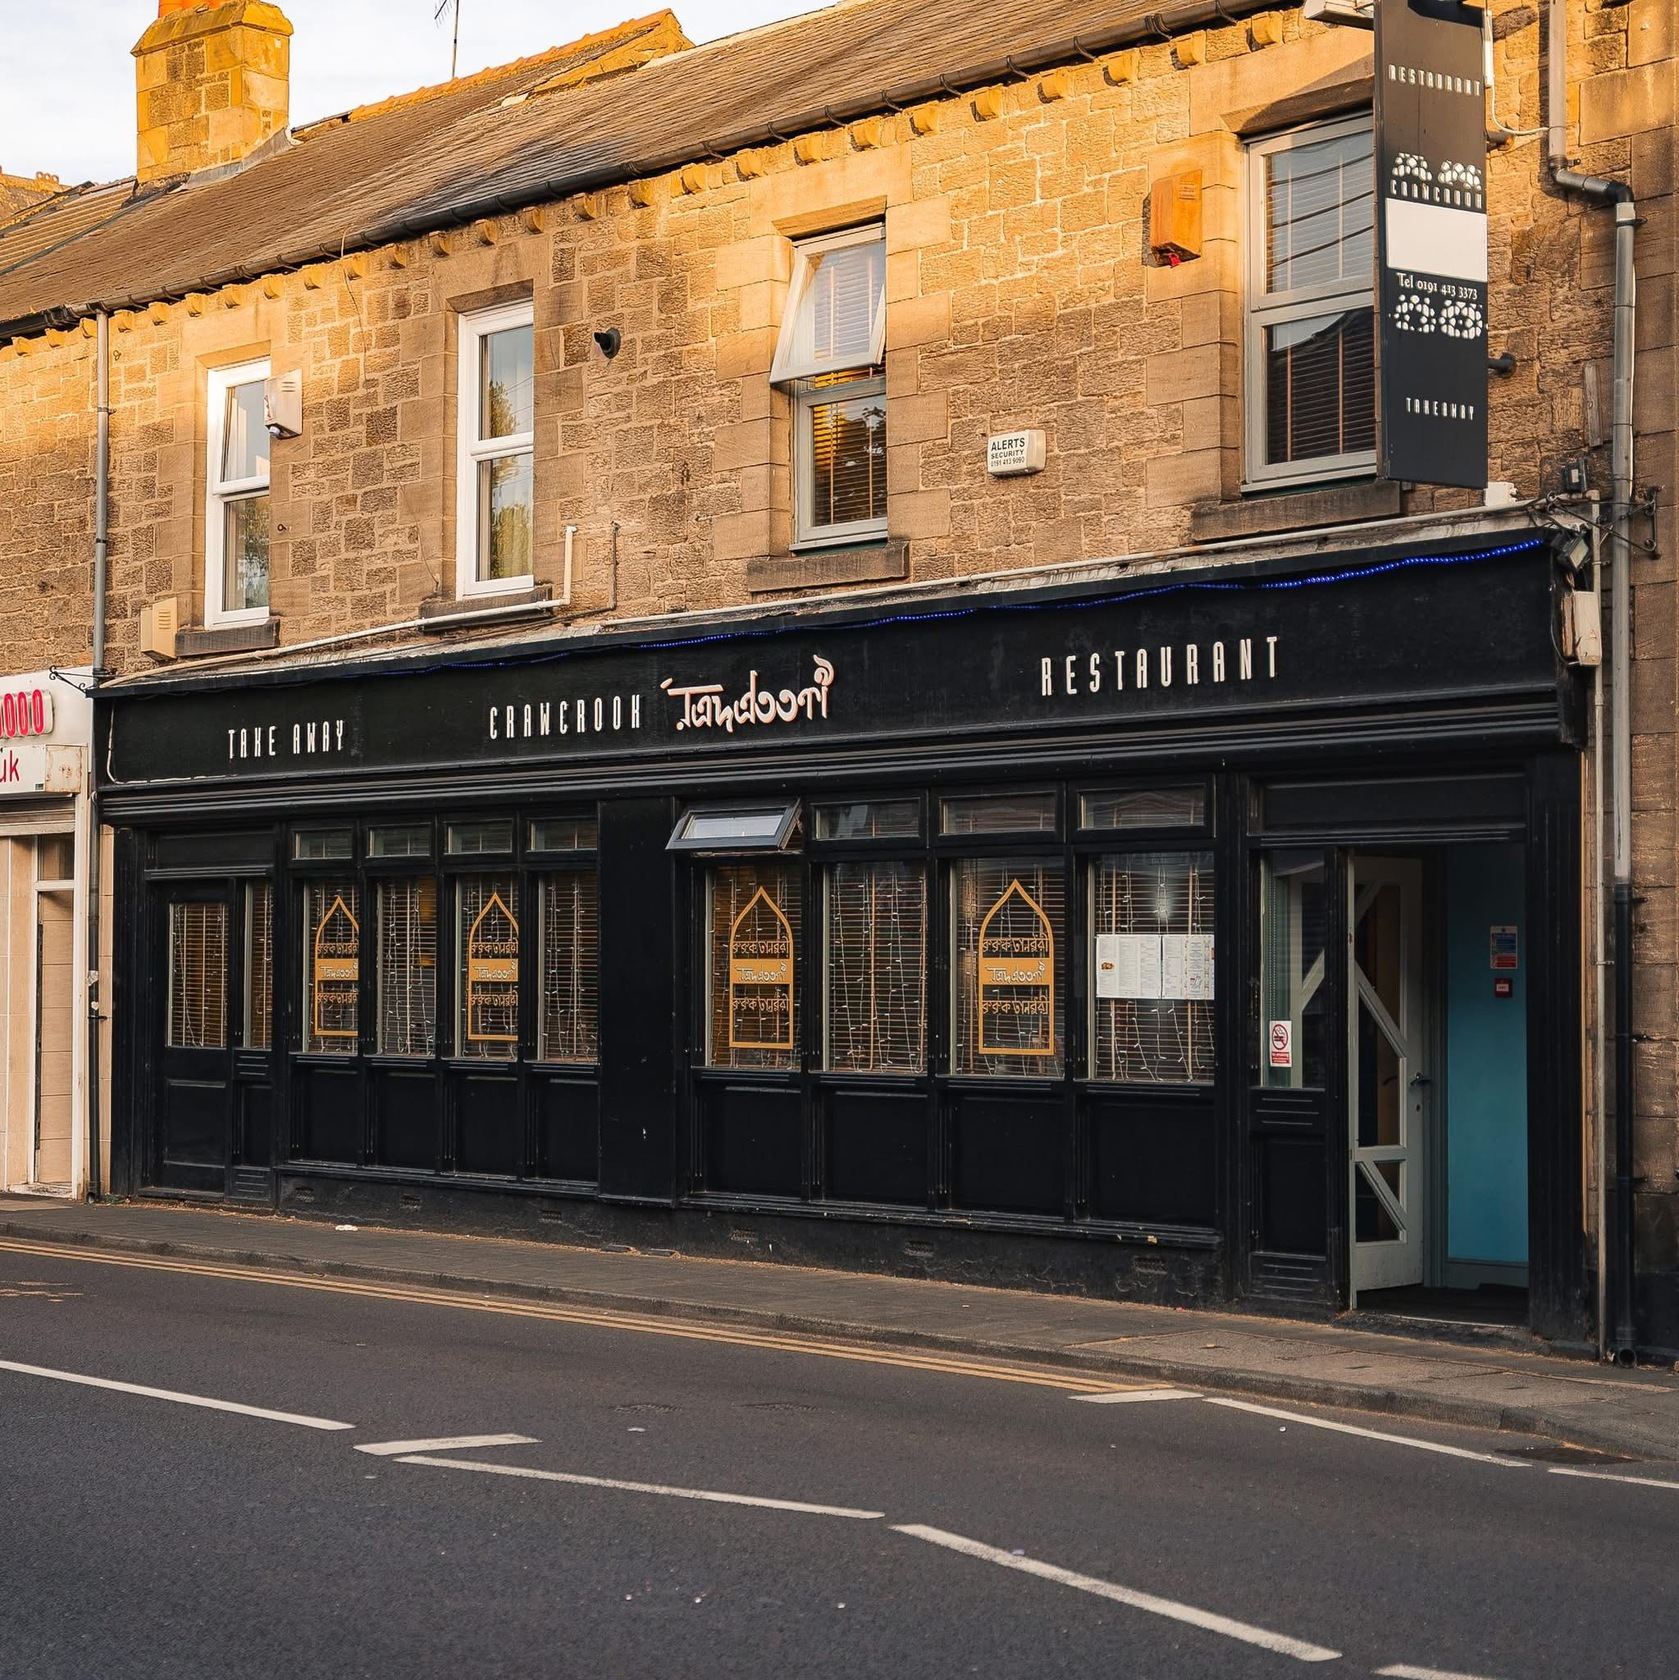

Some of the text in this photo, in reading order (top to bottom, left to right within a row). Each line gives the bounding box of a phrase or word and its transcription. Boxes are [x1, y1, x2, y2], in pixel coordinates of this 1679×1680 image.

[1388, 63, 1481, 97] RESTAURANT
[1396, 272, 1478, 300] Tel 0191 413 3373
[1405, 397, 1475, 421] TAKEAWAY
[991, 437, 1025, 451] ALERTS
[991, 449, 1024, 459] SECURITY
[1041, 636, 1278, 697] RESTAURANT
[0, 689, 44, 737] 000
[489, 654, 835, 740] CRAWCROOK Tandoori
[228, 719, 344, 760] TAKE AWAY
